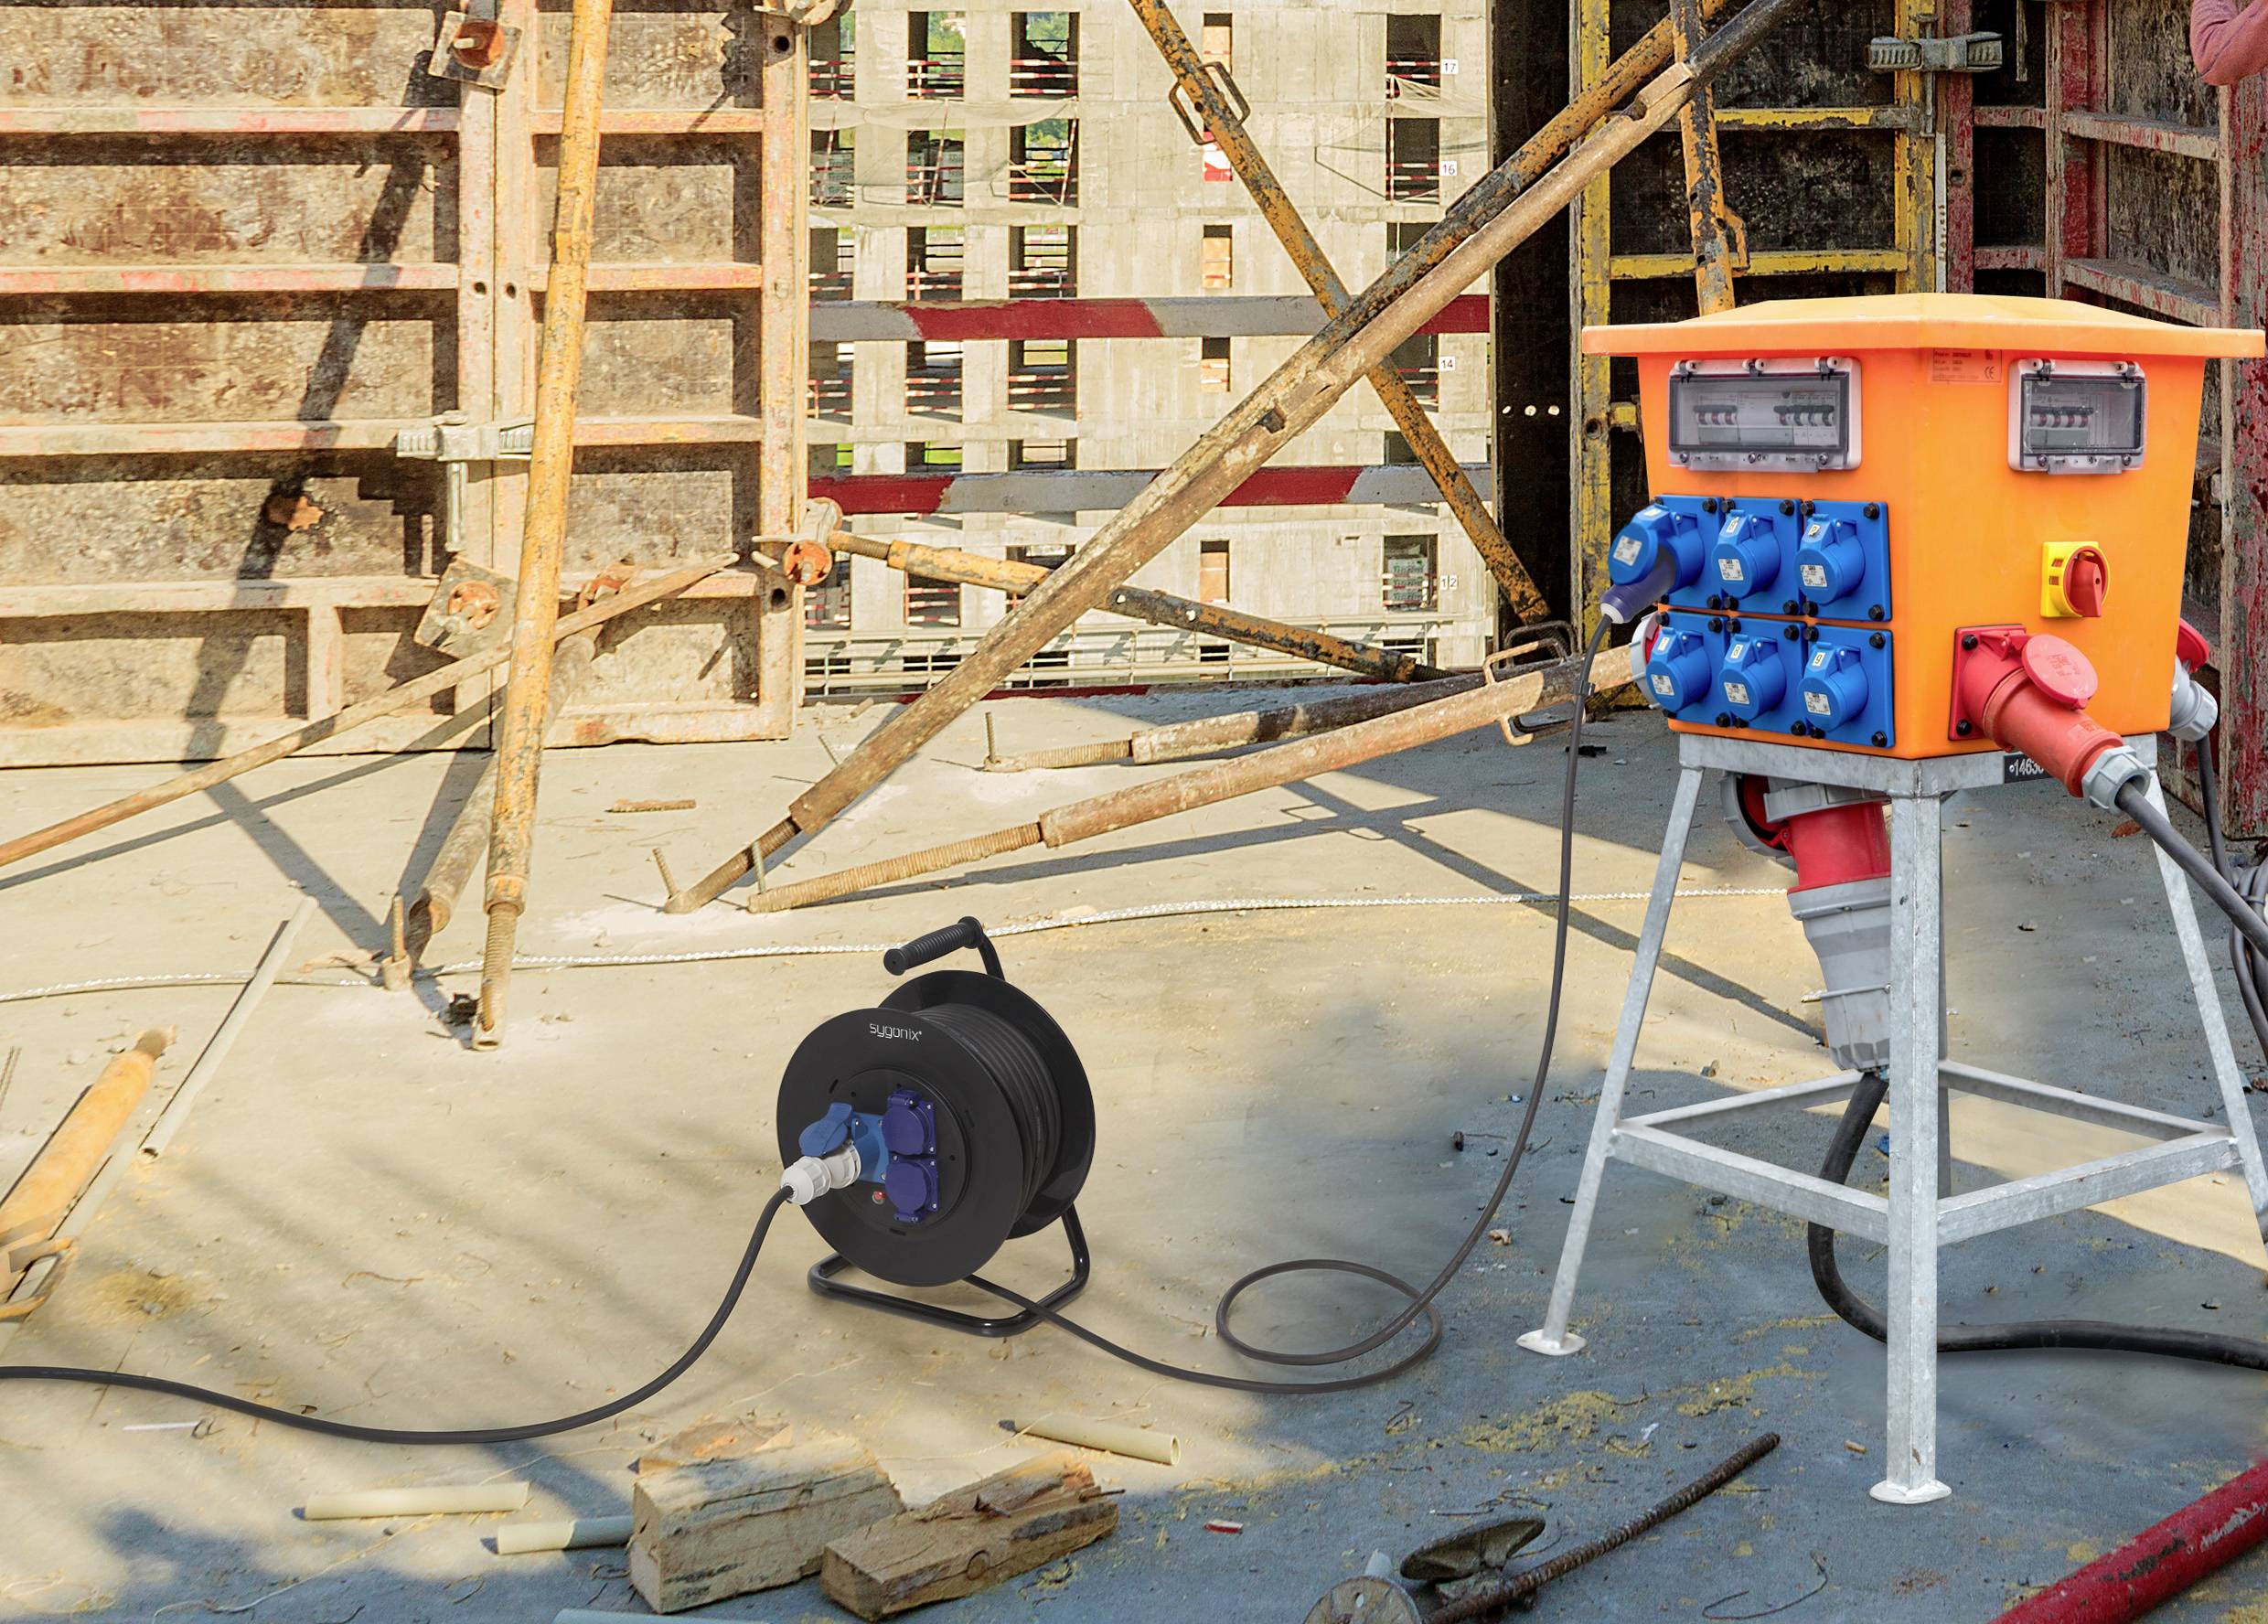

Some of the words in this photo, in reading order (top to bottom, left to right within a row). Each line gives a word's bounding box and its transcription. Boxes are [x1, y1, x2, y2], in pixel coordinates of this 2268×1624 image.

[1444, 62, 1457, 73] 17
[1442, 165, 1456, 176] 16
[1441, 359, 1453, 369] 14
[870, 1023, 919, 1042] sygonix
